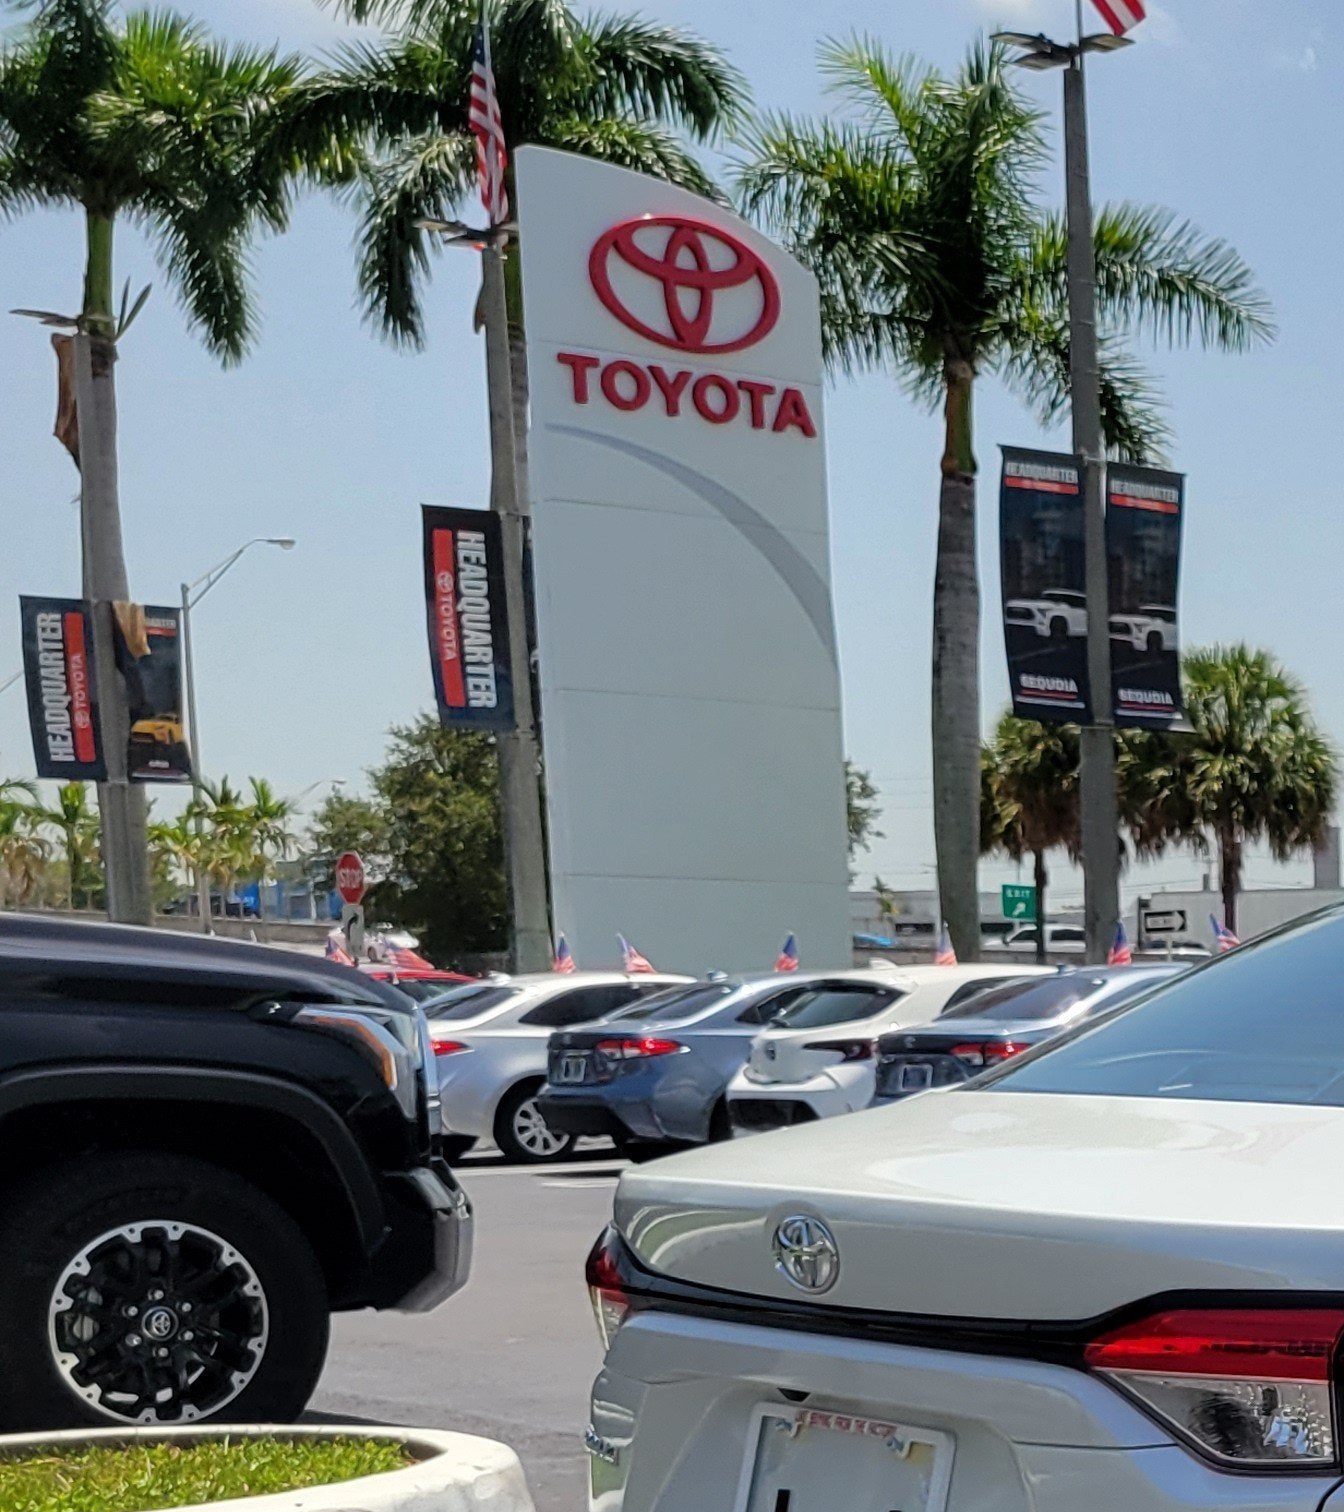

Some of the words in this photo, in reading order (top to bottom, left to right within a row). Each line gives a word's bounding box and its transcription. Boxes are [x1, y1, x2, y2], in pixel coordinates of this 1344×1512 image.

[557, 352, 817, 438] TOYOTA
[441, 597, 458, 661] TOYOTA
[457, 529, 498, 709] HEADQUARTER
[36, 612, 76, 762] HEADQUARTER
[70, 653, 89, 708] TOYOTA
[1019, 673, 1078, 693] SEQUOIA
[1117, 688, 1173, 706] SEQUOIA
[339, 868, 362, 888] STOP
